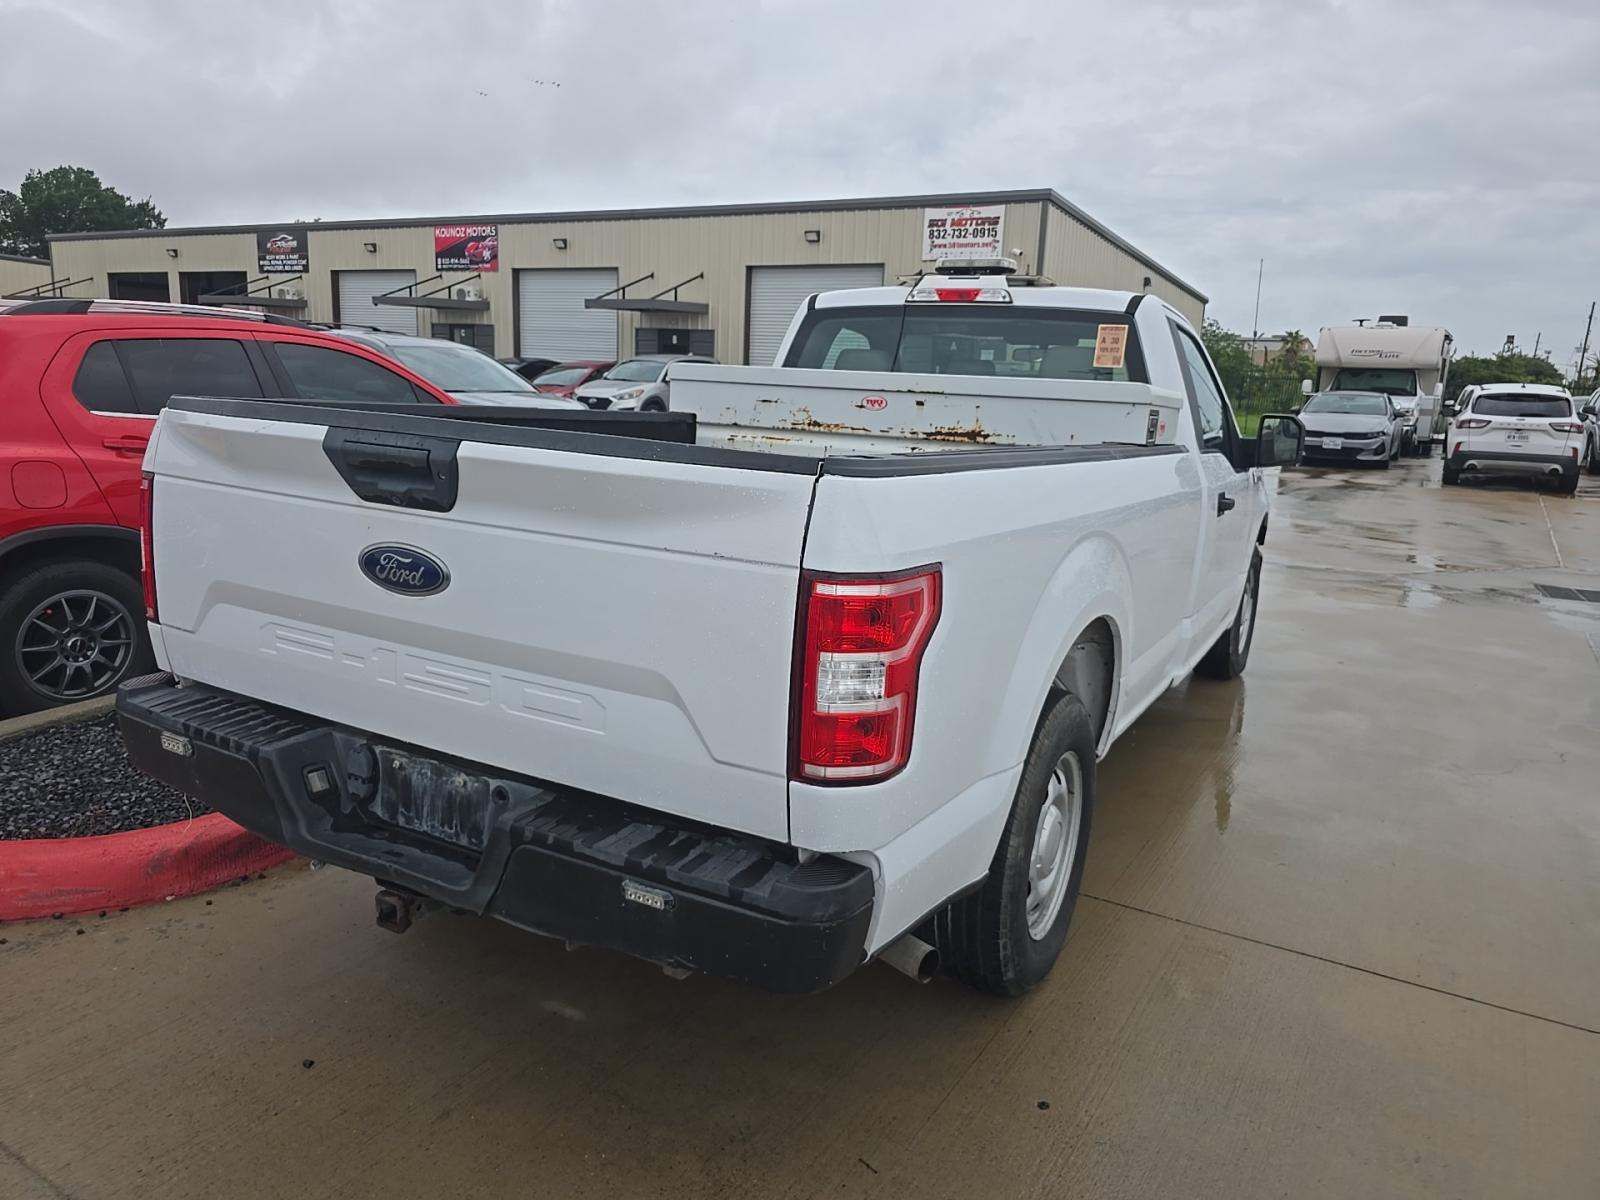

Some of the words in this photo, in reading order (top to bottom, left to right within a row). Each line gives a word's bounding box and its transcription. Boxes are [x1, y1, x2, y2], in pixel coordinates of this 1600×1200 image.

[950, 216, 1001, 228] MOTORS
[435, 227, 466, 239] KOUNOZ
[466, 226, 497, 238] MOTORS
[928, 227, 998, 240] 832-732-0915
[376, 552, 425, 586] Ford
[259, 621, 607, 736] F-150
